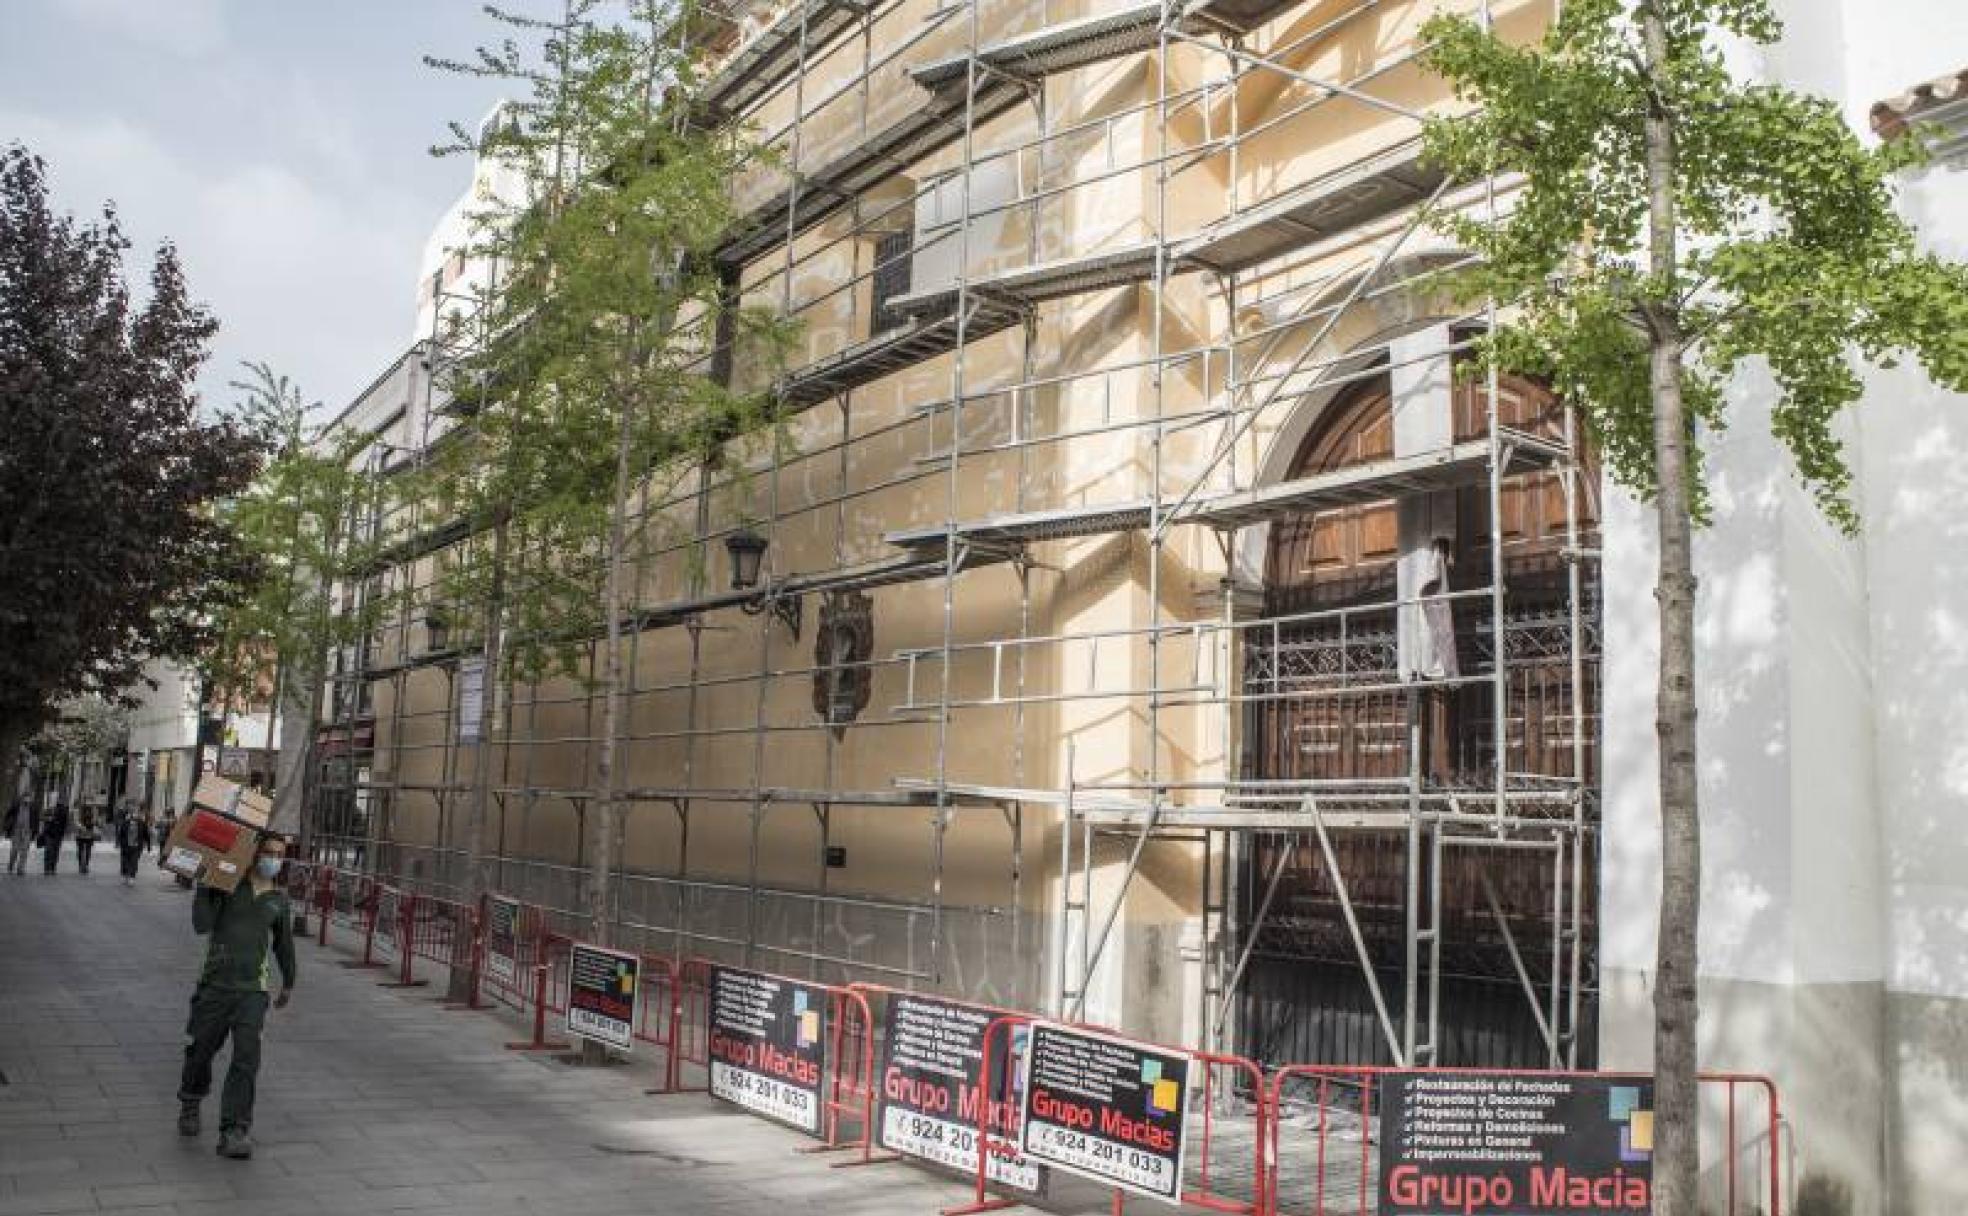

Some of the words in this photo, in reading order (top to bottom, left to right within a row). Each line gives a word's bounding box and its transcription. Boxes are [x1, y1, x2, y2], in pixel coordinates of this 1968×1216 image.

[759, 1041, 819, 1086] Macias
[885, 1066, 949, 1114] Grupo
[957, 1083, 1022, 1131] Mcia
[1032, 1089, 1093, 1129] Grupo
[1101, 1106, 1175, 1150] Macias
[1478, 1096, 1487, 1107] y
[911, 1117, 943, 1142] 924
[1055, 1130, 1086, 1149] 924
[1091, 1140, 1123, 1164] 201
[1128, 1152, 1162, 1174] 033
[1389, 1164, 1514, 1215] Grupo
[1528, 1165, 1653, 1208] Macia
